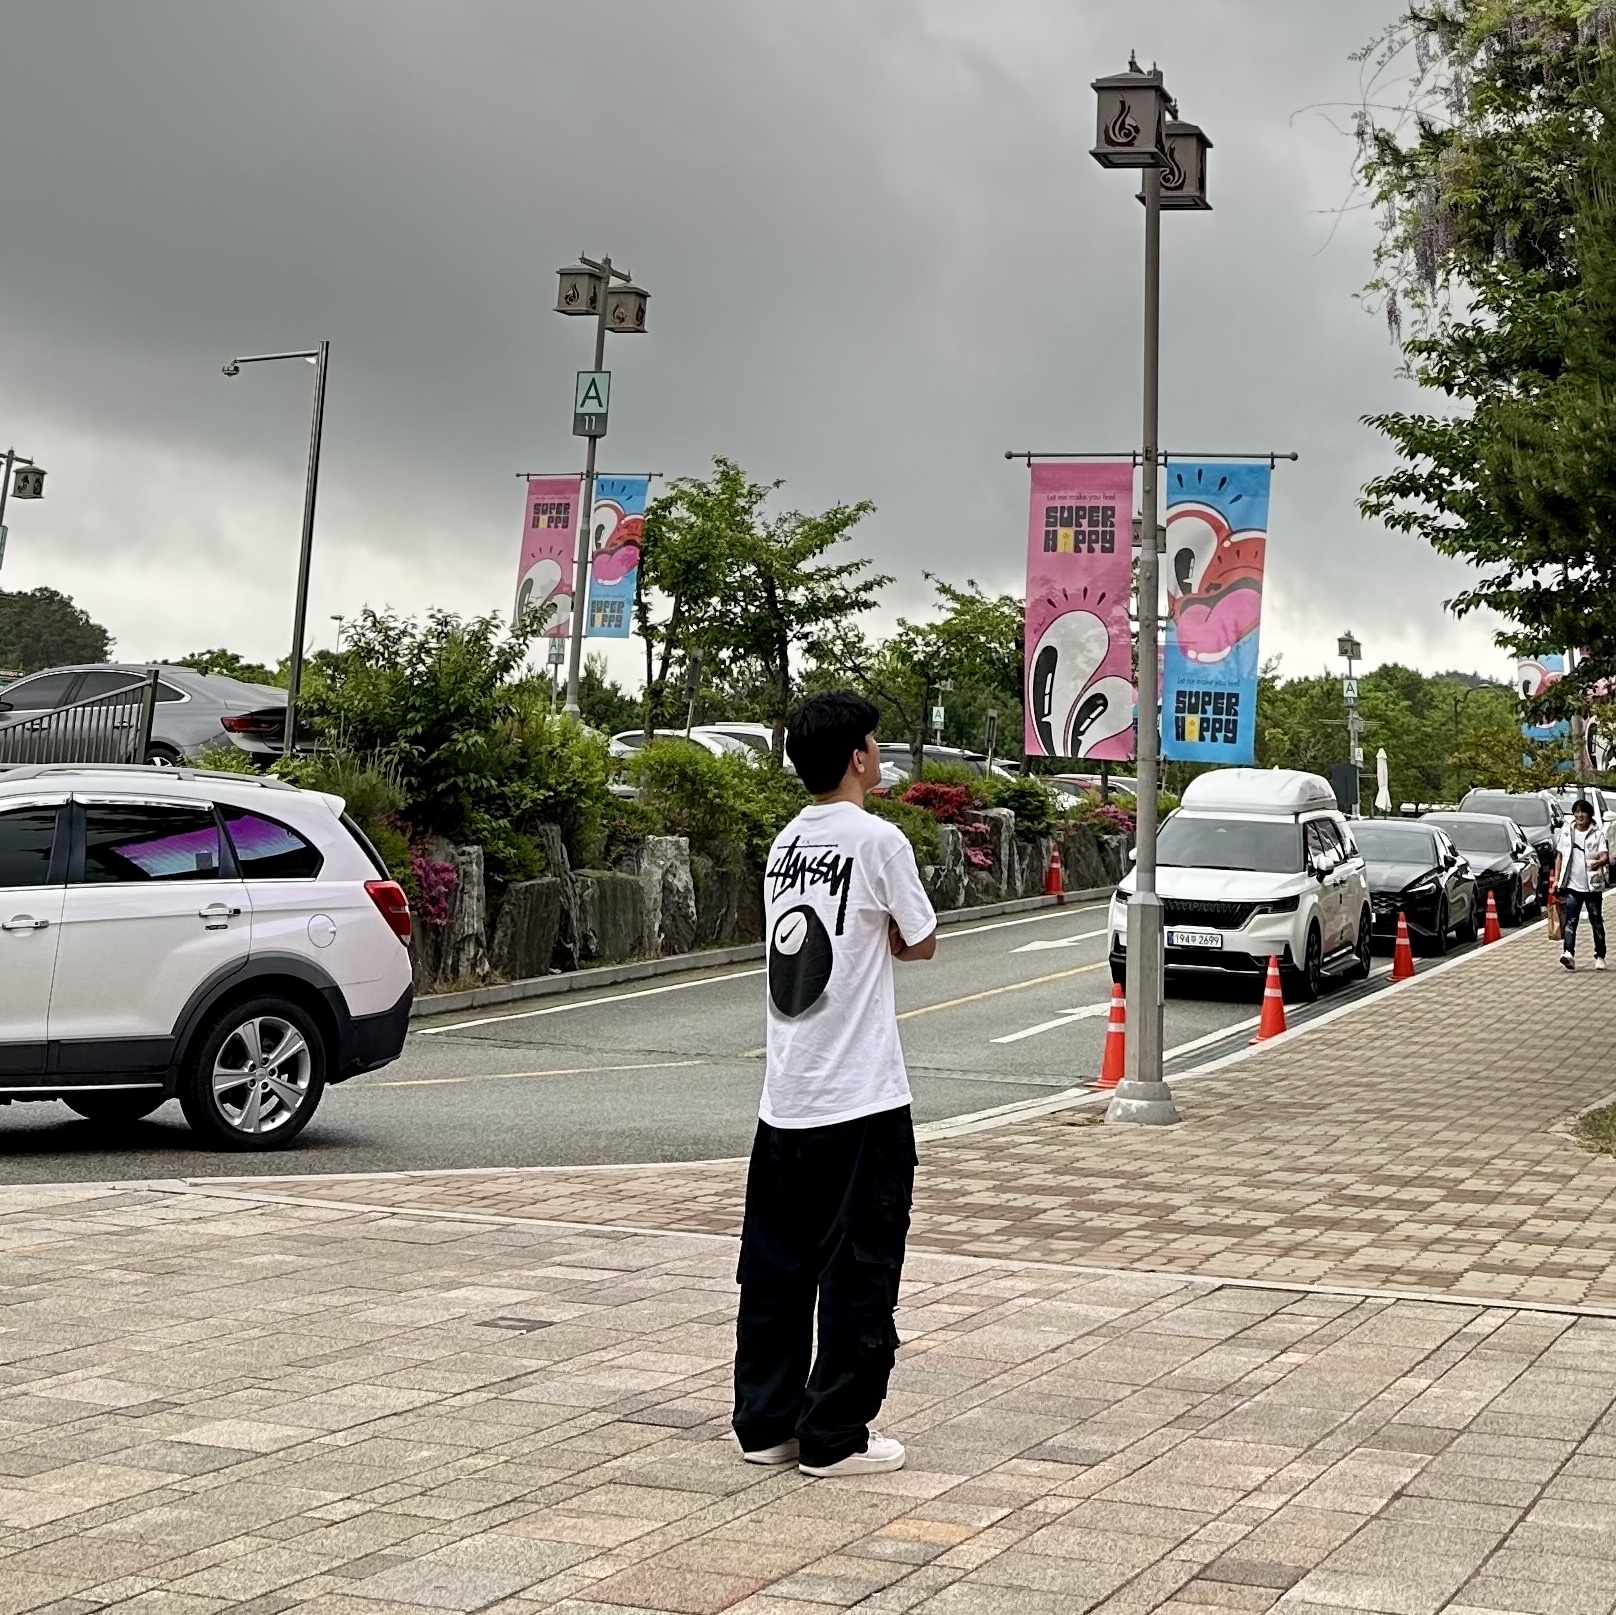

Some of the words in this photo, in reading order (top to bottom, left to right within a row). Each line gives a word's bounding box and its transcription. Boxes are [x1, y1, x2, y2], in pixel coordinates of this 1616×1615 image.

[580, 377, 603, 408] A
[584, 415, 596, 431] 11
[533, 503, 571, 515] SUPER
[1045, 505, 1115, 528] SUPER
[1346, 681, 1355, 694] A
[1175, 690, 1240, 717] SUPER
[933, 709, 943, 720] A
[1199, 935, 1220, 946] 2699
